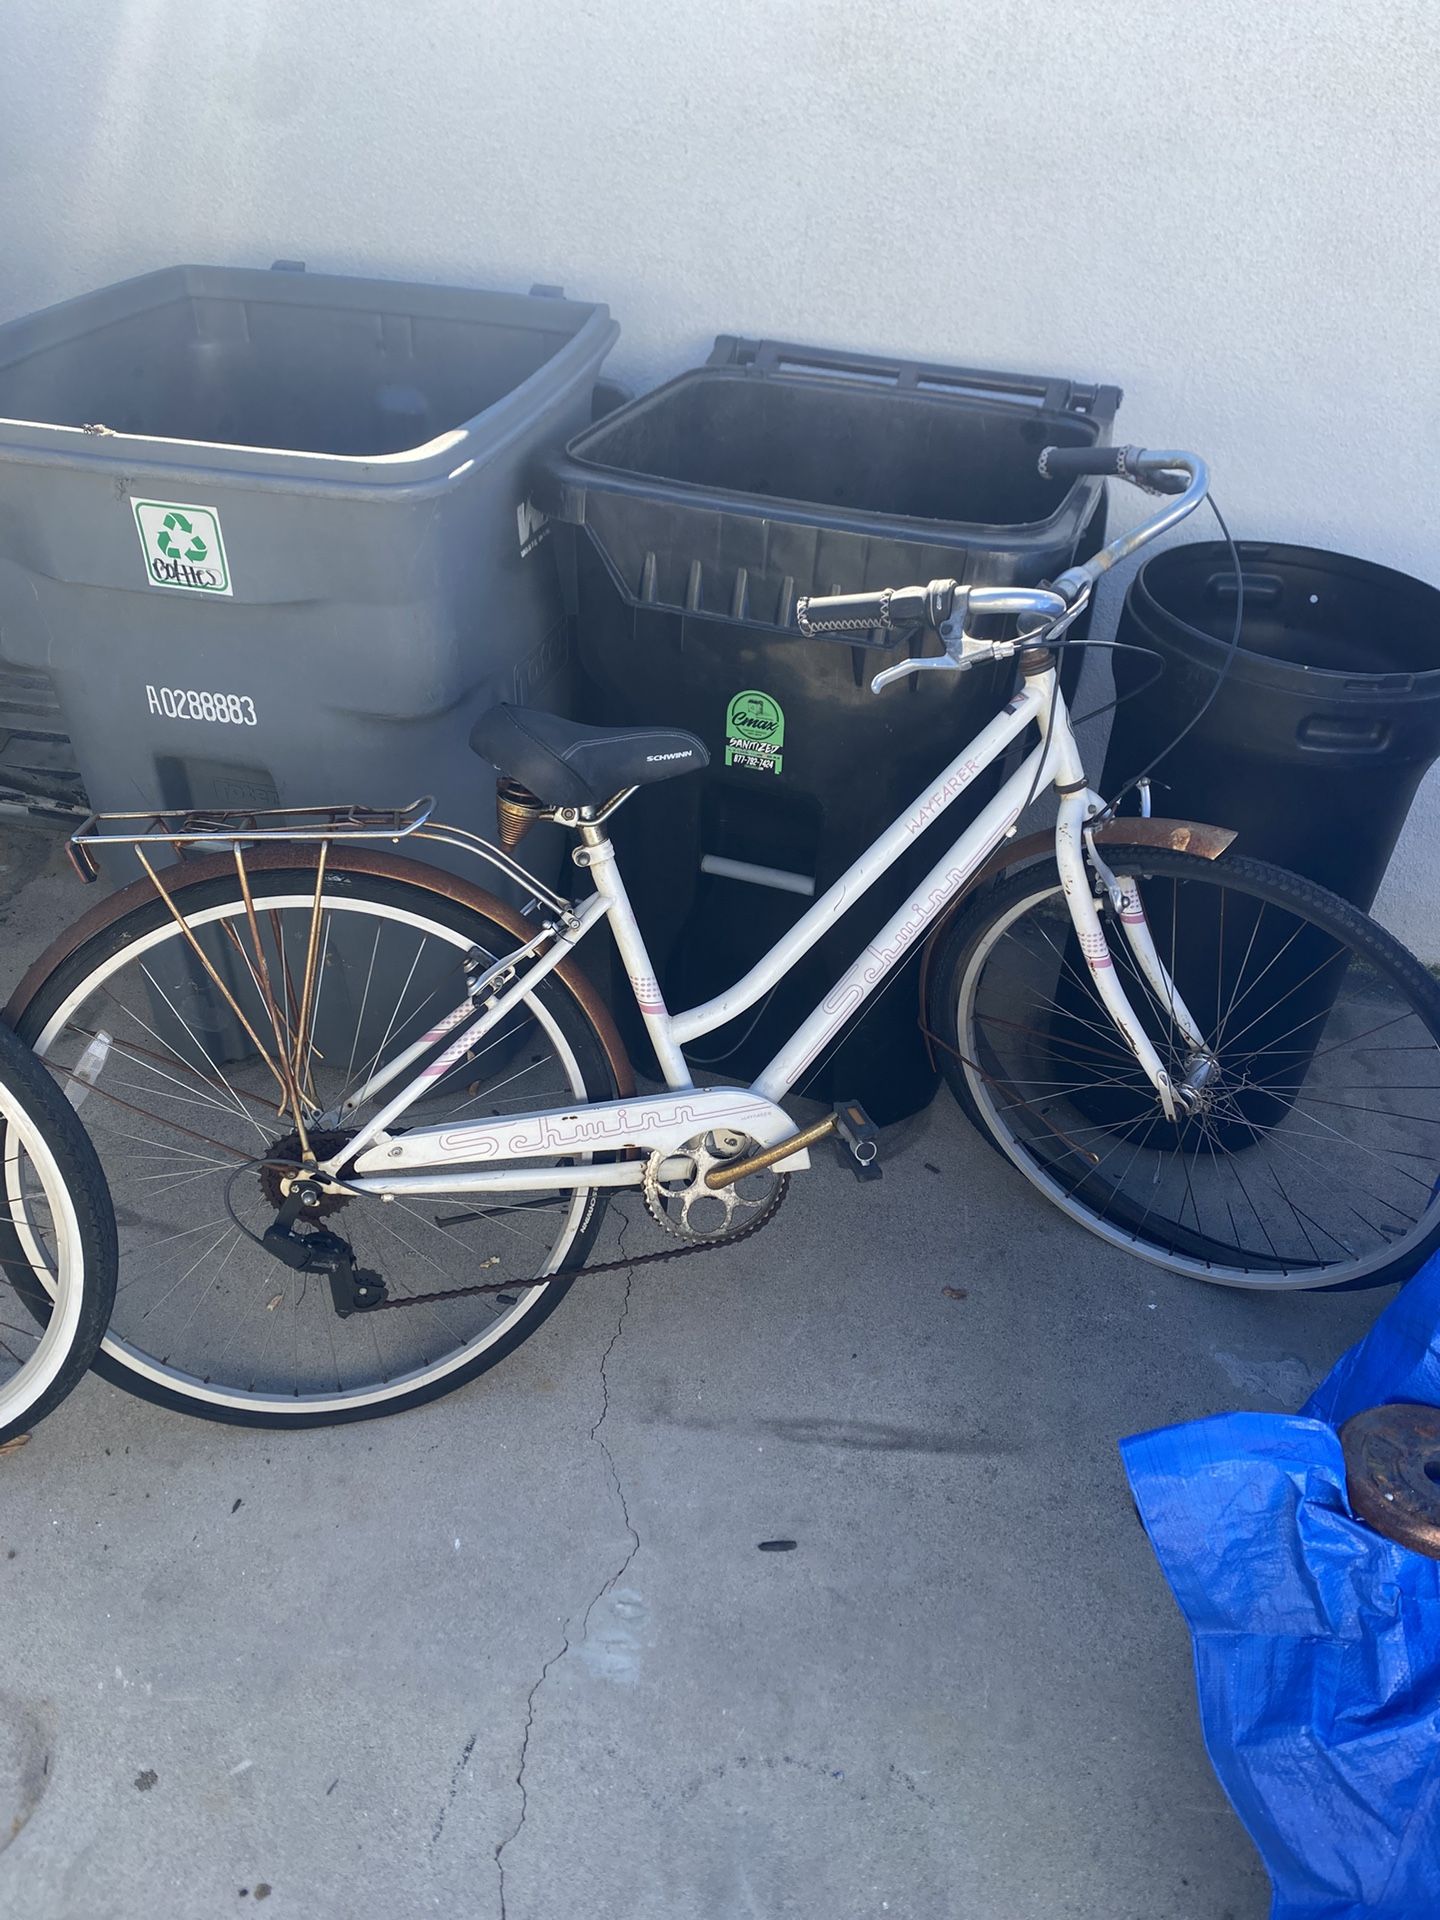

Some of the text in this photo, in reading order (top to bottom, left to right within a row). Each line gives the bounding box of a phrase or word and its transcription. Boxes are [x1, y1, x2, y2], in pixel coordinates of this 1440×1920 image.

[732, 711, 779, 731] Cmax
[646, 749, 692, 762] SCHWINN
[729, 737, 780, 754] SANITIZED
[904, 759, 980, 834] WAYFARER
[439, 1104, 699, 1158] Schwinn
